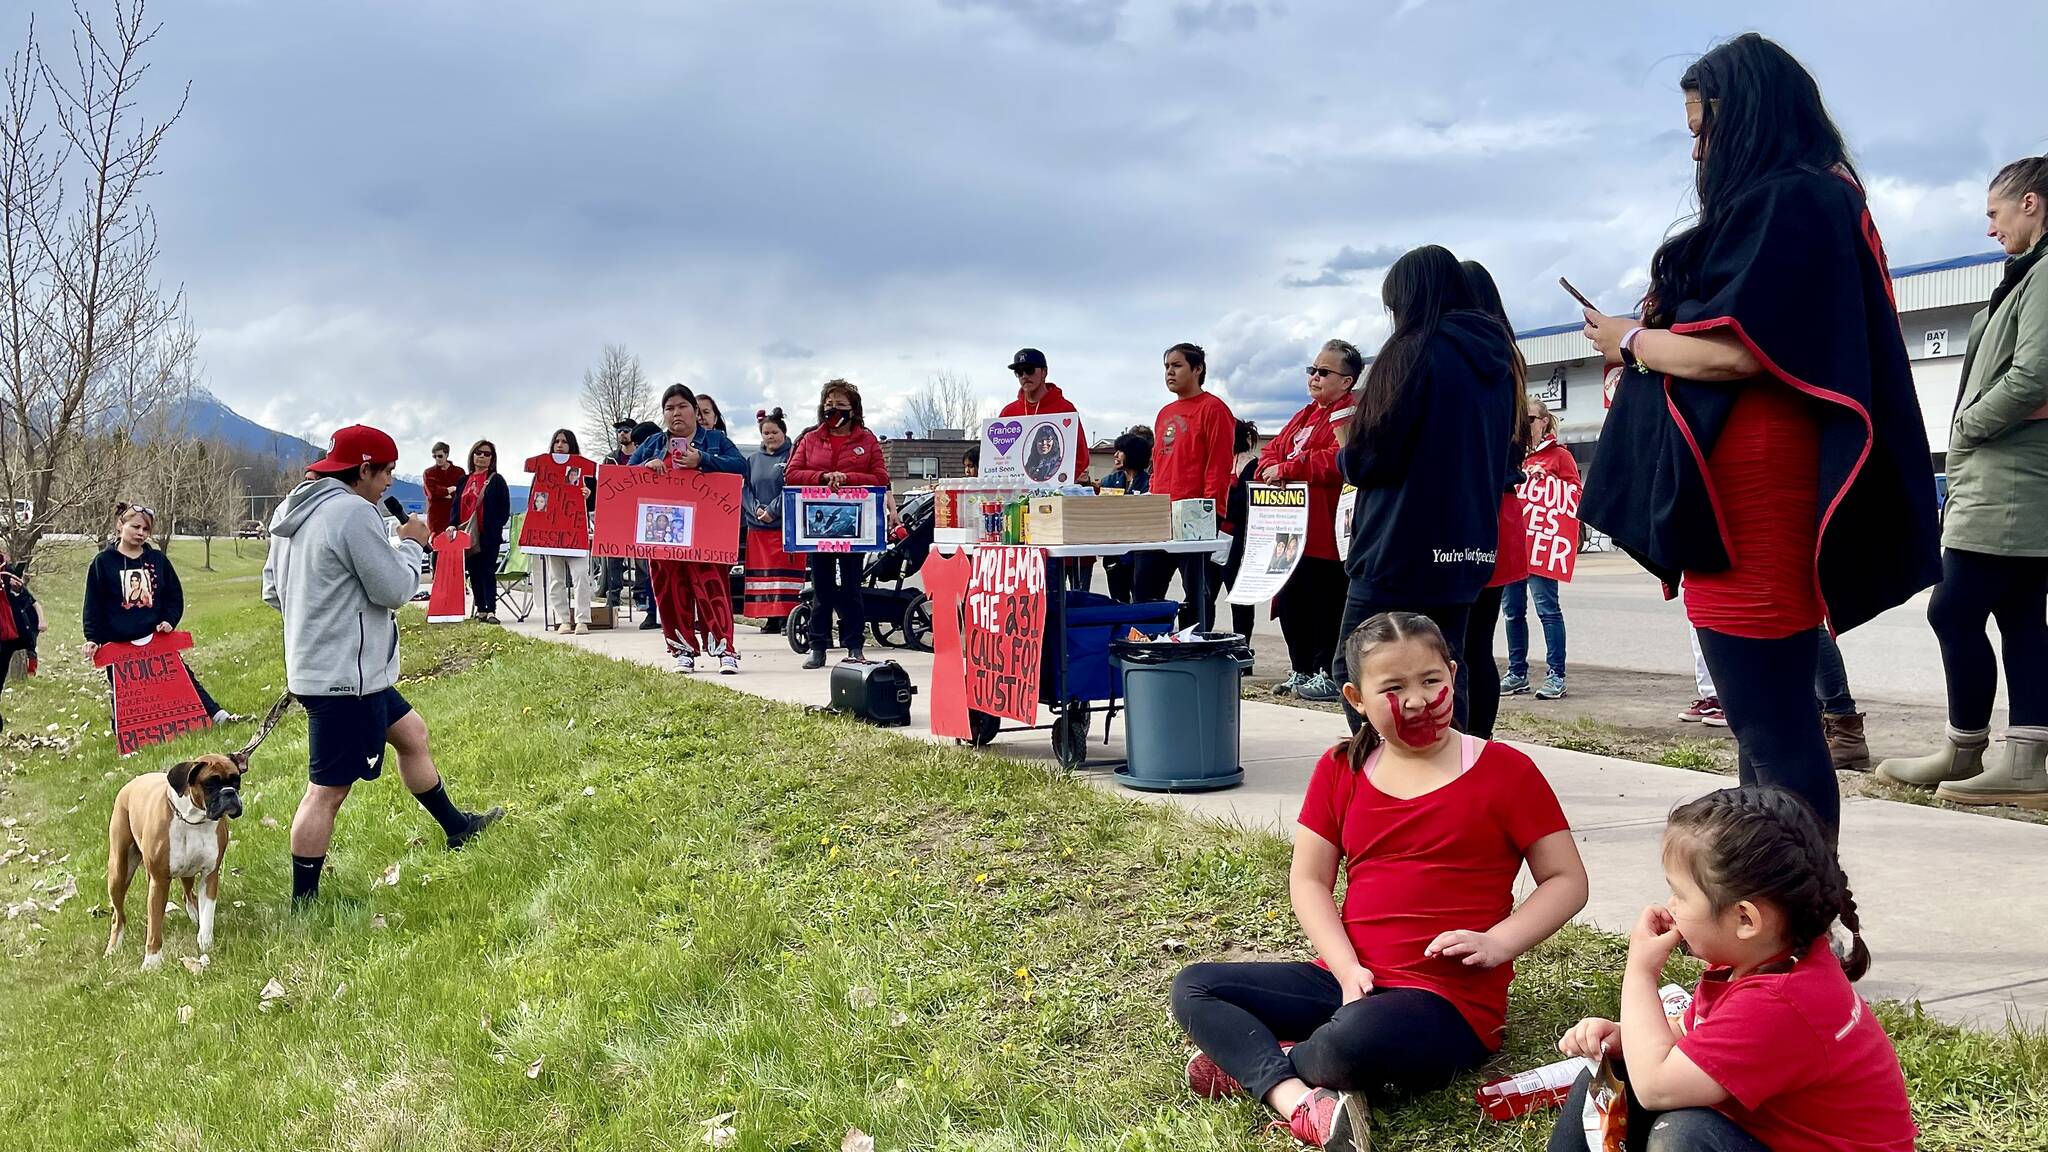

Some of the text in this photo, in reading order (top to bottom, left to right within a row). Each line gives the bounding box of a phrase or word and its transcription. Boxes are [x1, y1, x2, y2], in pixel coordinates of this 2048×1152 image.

[1927, 331, 1946, 341] BAY
[1932, 342, 1941, 354] 2
[989, 426, 1021, 435] Frances
[993, 437, 1016, 445] Brown
[600, 468, 739, 515] Justice for Crystal
[801, 487, 869, 499] HELP FIND
[1253, 489, 1304, 505] MISSING
[598, 543, 738, 563] NO MORE STOLEN SISTERS
[817, 540, 851, 552] FRAN
[1432, 549, 1464, 562] You're
[970, 592, 1039, 638] THE 231
[971, 628, 1038, 688] CALLS FOR
[113, 652, 177, 682] VOICE
[974, 669, 1033, 724] JUSTICE
[117, 715, 209, 754] RESPECT
